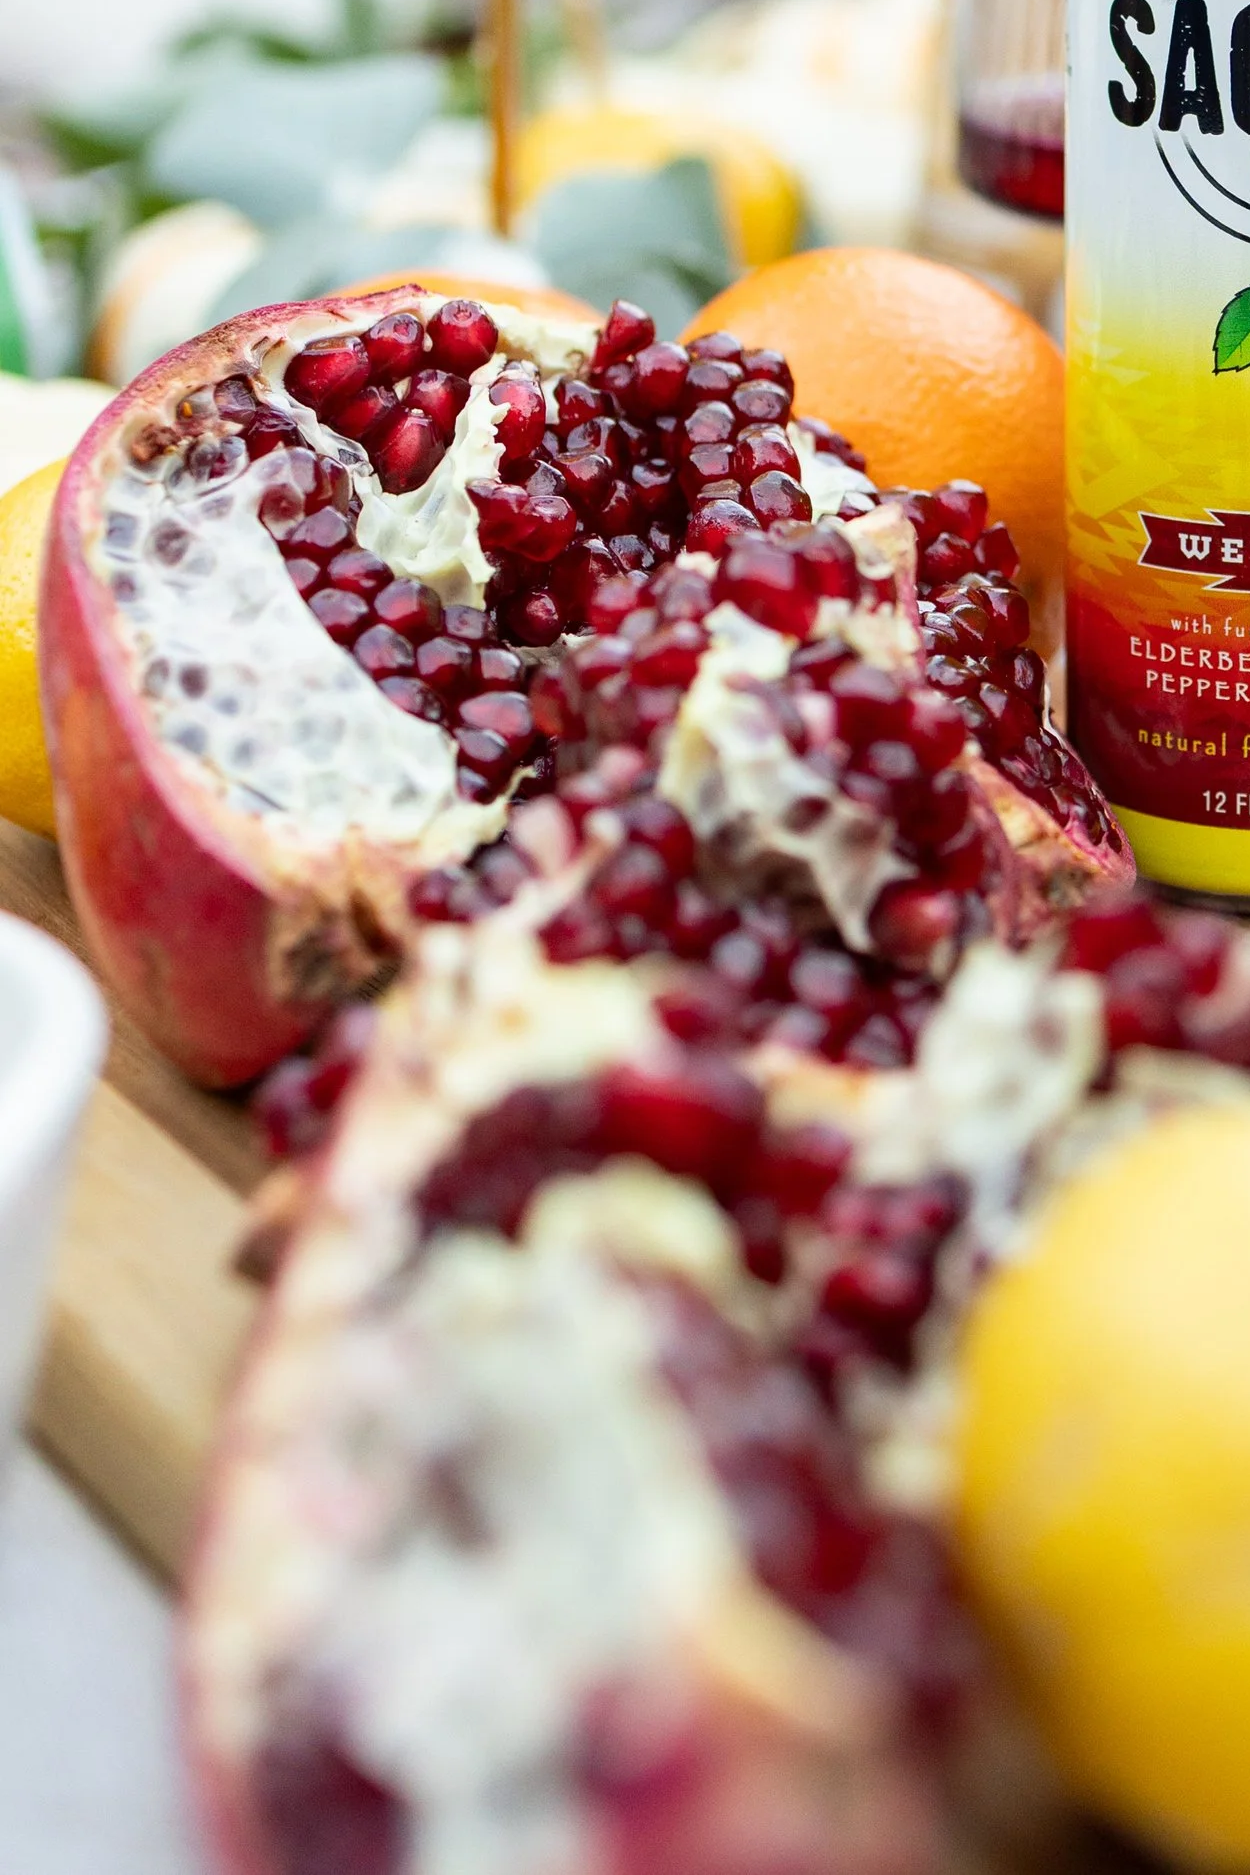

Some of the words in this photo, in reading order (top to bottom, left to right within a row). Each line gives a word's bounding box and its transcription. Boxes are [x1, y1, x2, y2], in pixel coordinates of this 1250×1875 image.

[1171, 614, 1212, 635] with
[1138, 729, 1227, 757] natural
[1203, 790, 1226, 813] 12
